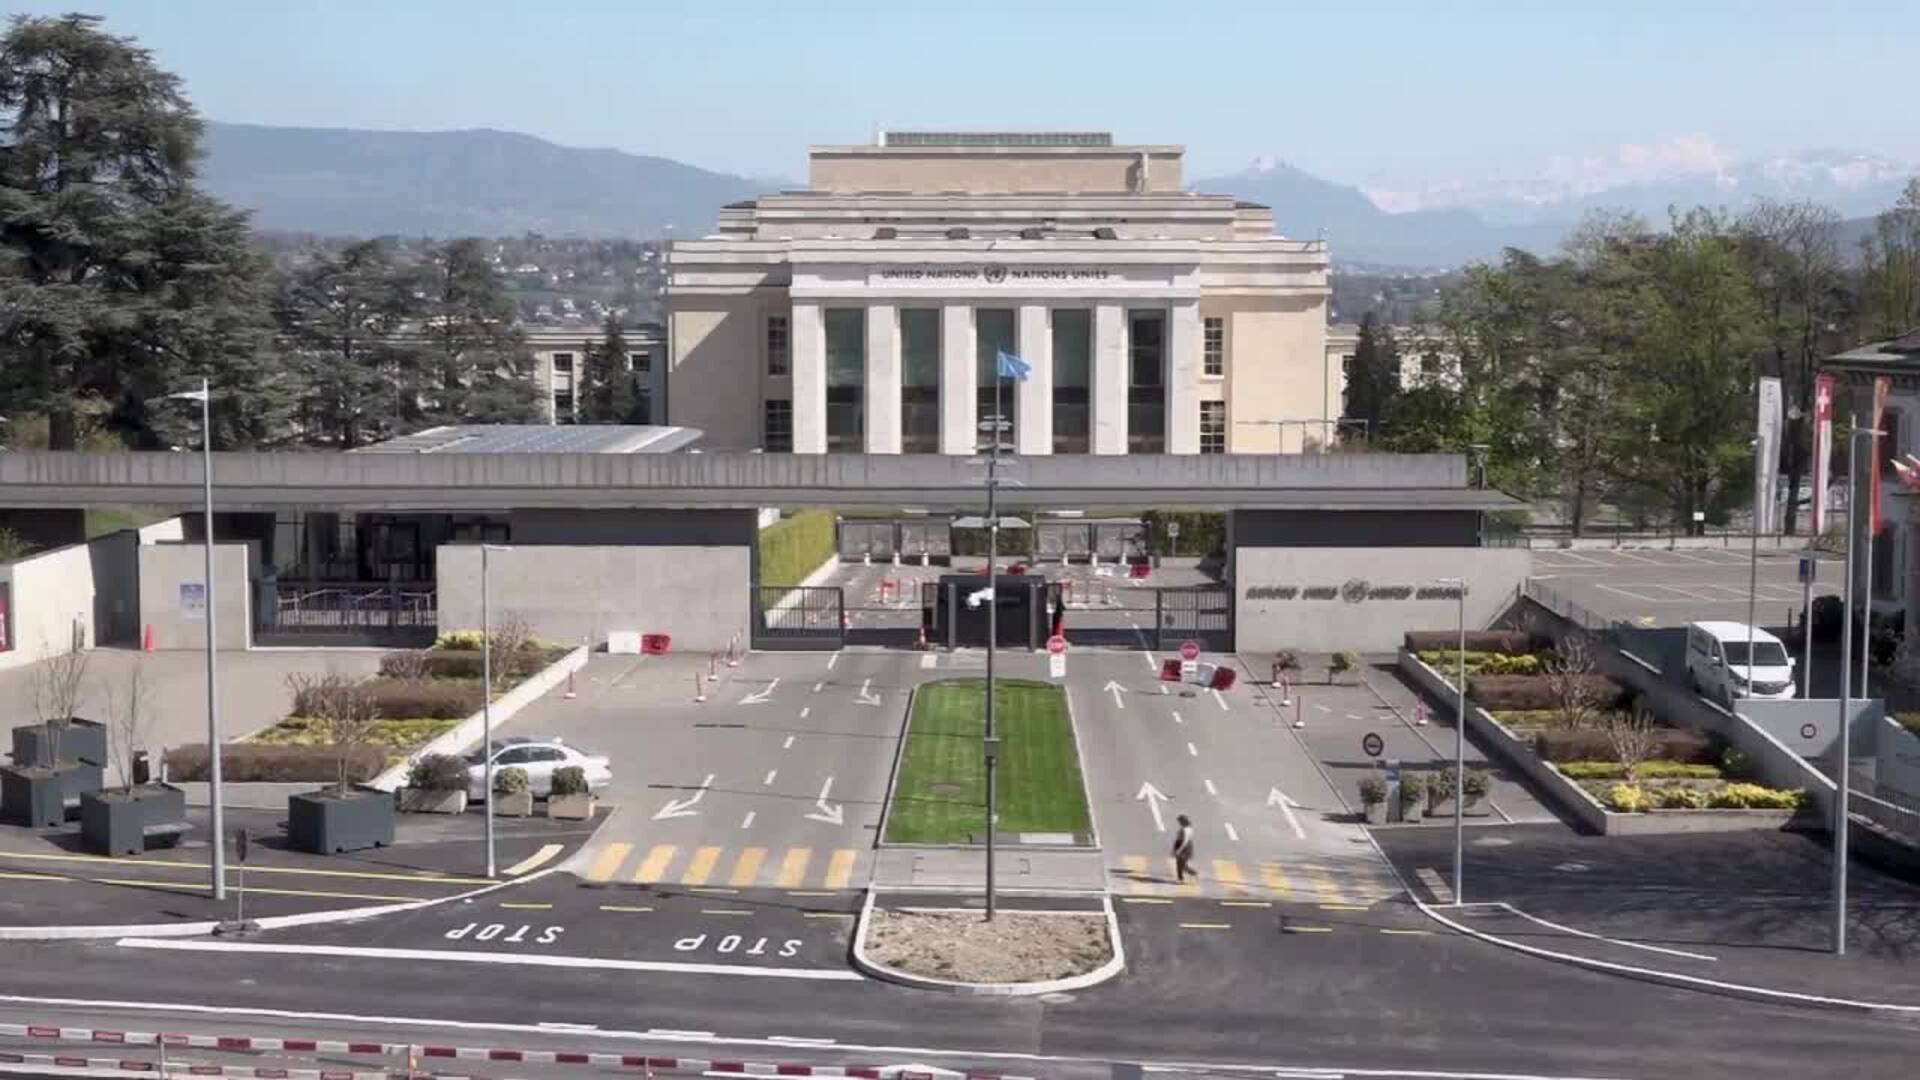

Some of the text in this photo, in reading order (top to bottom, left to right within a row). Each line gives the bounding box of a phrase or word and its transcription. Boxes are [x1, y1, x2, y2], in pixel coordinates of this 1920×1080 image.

[882, 269, 1108, 279] UNITED NATIONS NATIONS UNIES
[444, 922, 565, 943] STOP
[674, 934, 804, 957] STOP
